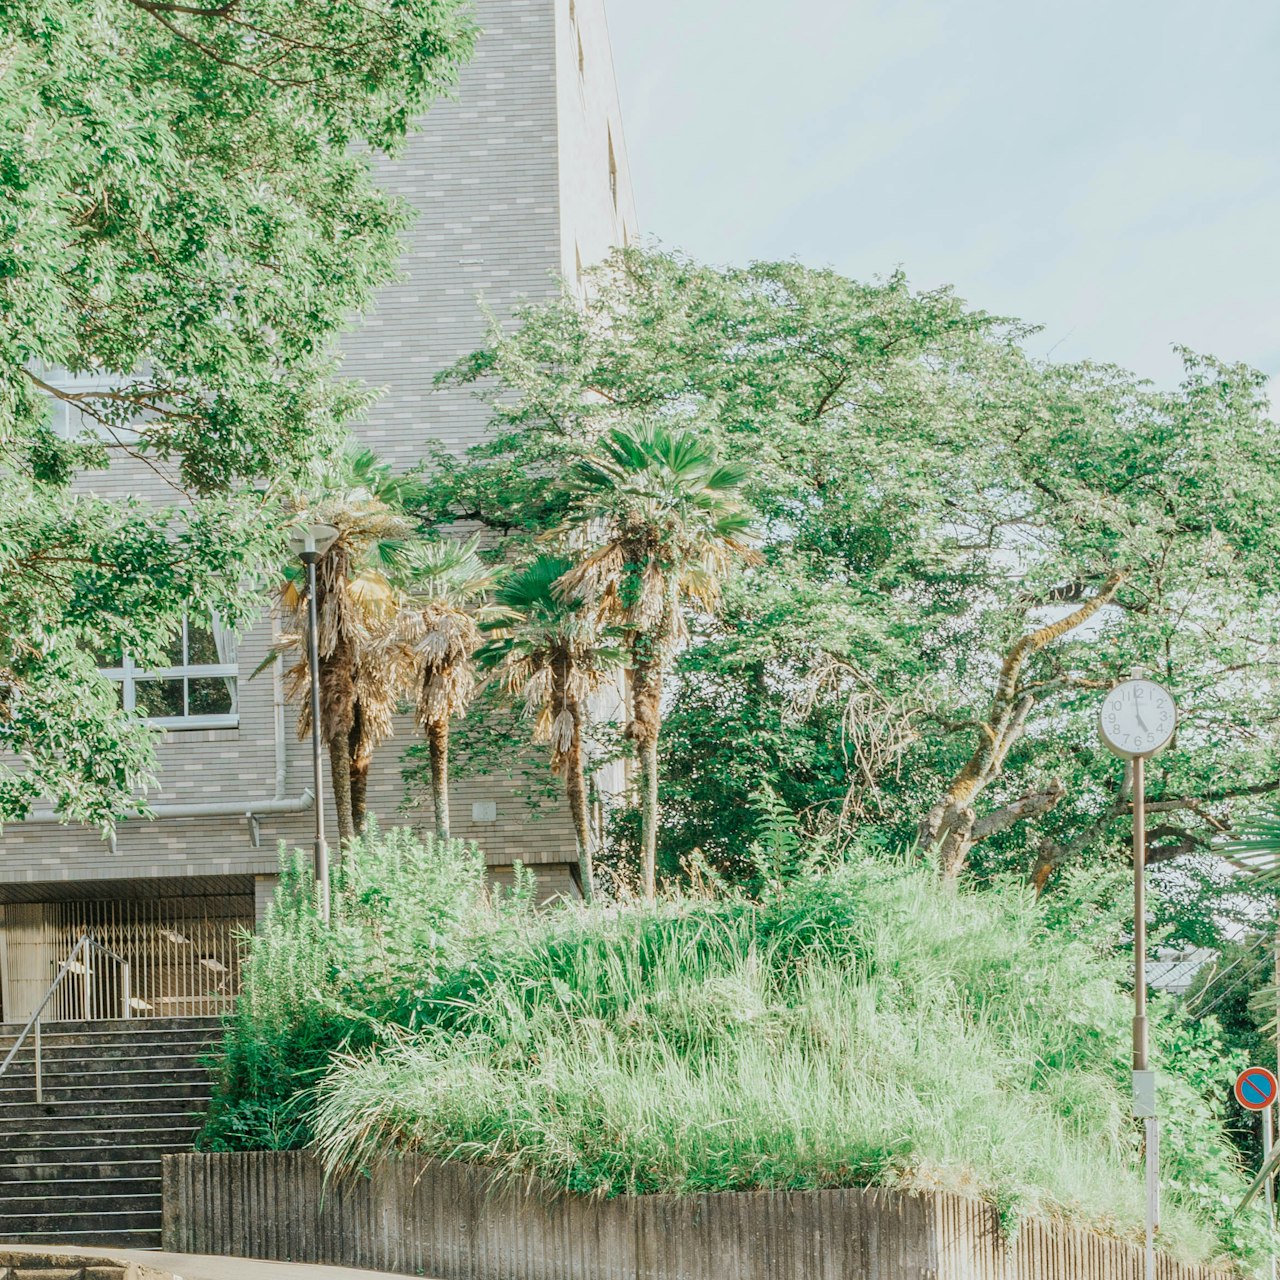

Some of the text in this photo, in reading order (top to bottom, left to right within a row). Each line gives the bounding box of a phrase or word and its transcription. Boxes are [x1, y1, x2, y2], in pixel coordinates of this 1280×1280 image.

[1156, 698, 1164, 709] 2
[1108, 713, 1116, 723] 9
[1160, 711, 1168, 721] 3
[1113, 724, 1121, 734] 8
[1156, 723, 1164, 734] 4
[1122, 733, 1130, 744] 7
[1134, 736, 1142, 747] 6
[1147, 732, 1155, 743] 5
